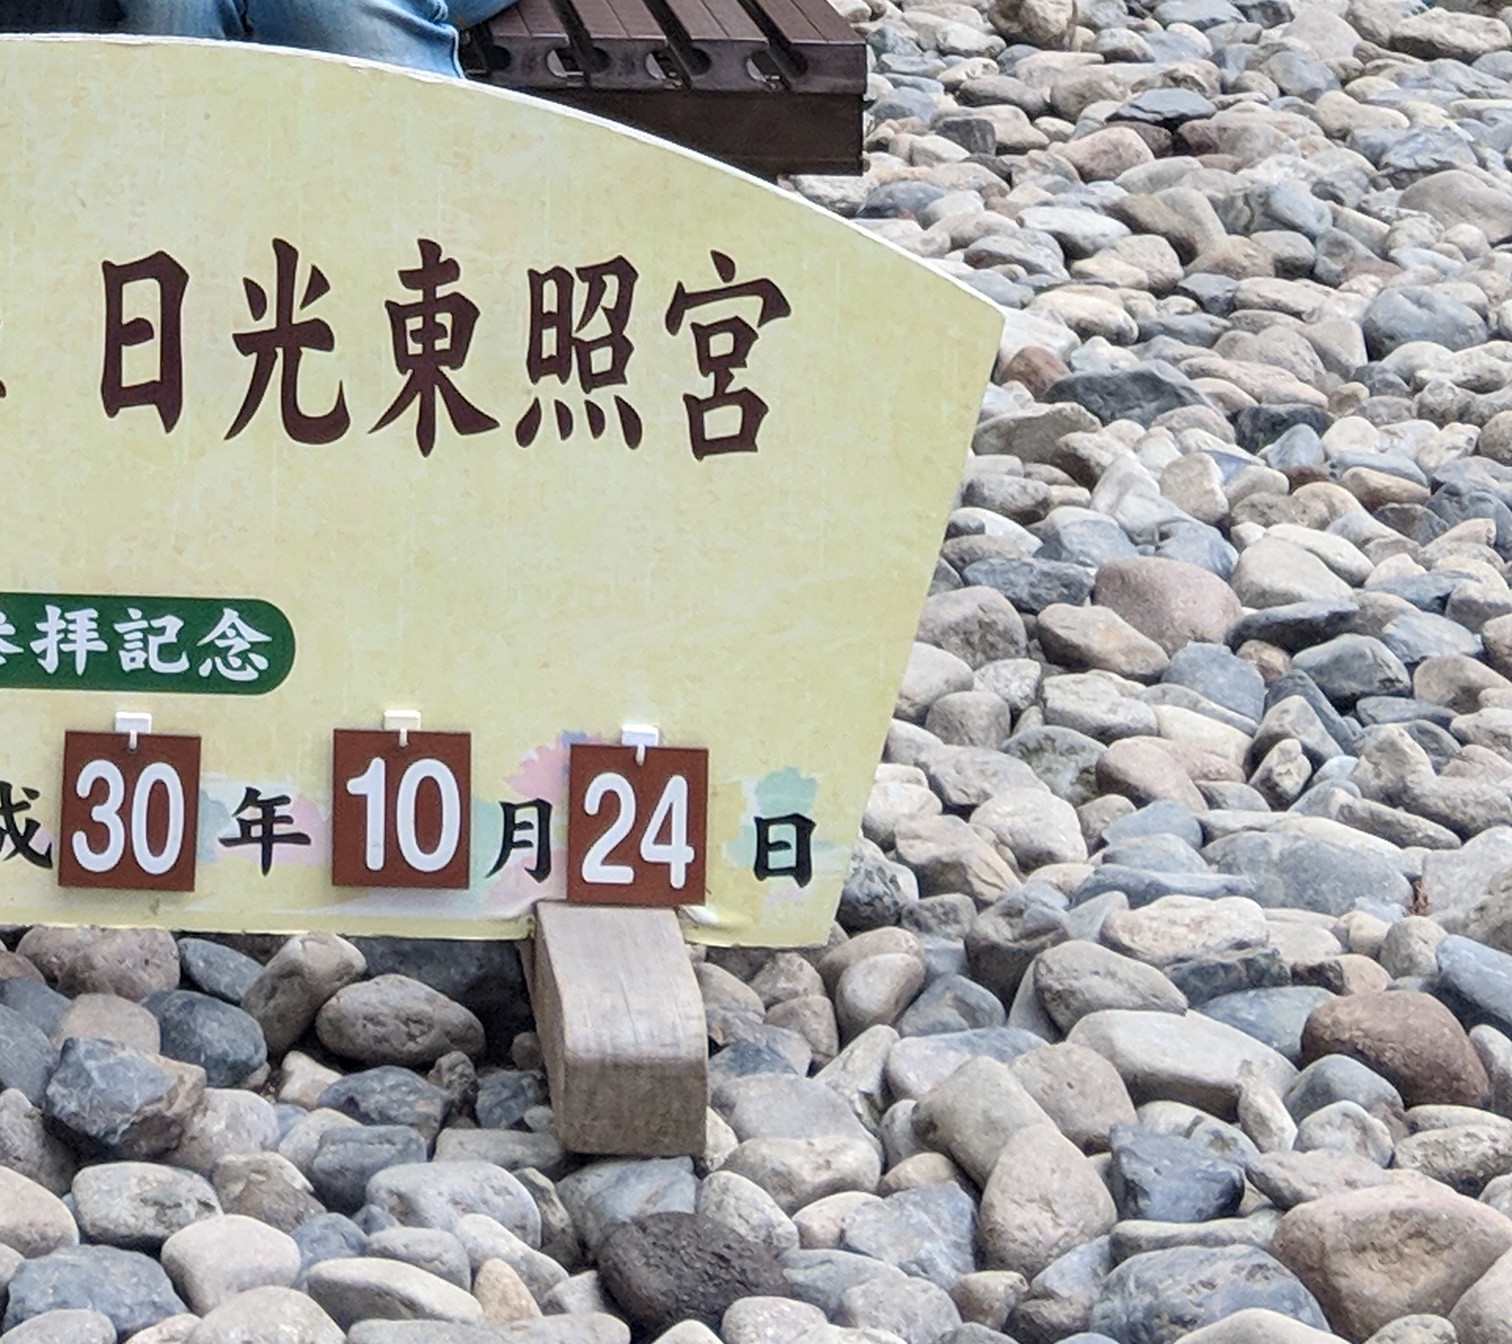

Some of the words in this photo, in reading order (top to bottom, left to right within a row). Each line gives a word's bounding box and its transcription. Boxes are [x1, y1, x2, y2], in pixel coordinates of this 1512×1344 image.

[100, 238, 792, 461] 日光東照宮
